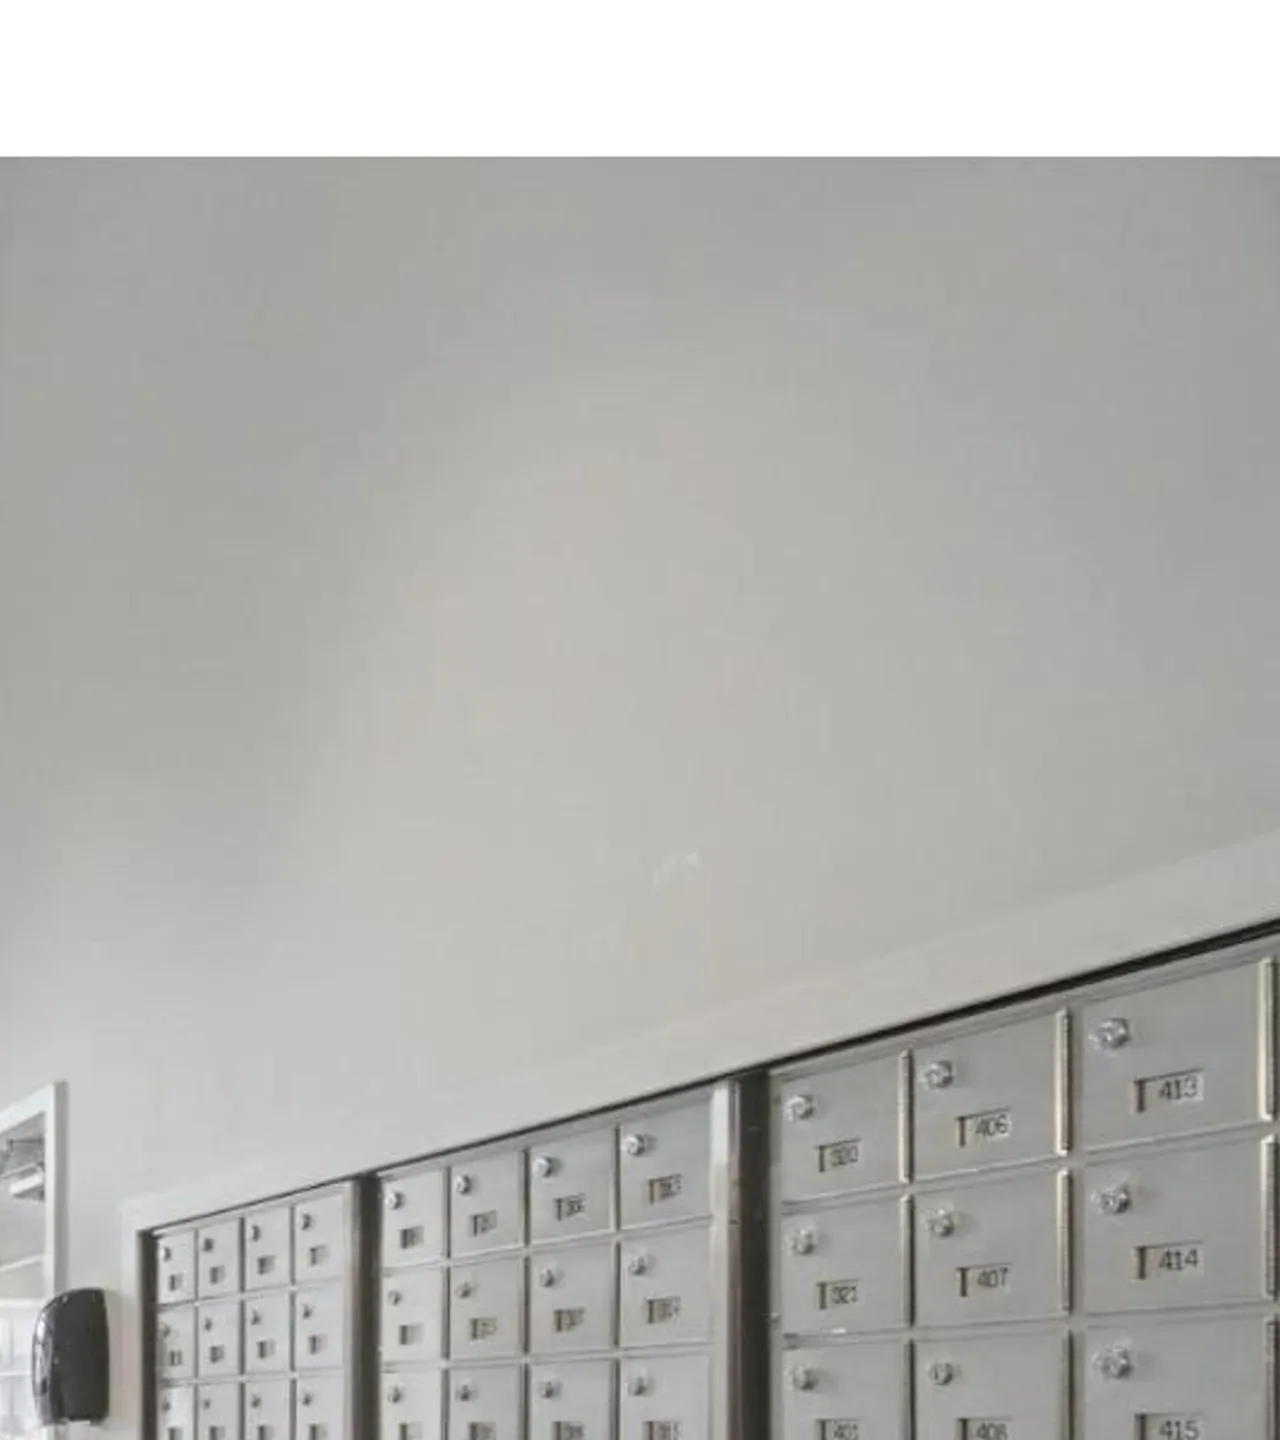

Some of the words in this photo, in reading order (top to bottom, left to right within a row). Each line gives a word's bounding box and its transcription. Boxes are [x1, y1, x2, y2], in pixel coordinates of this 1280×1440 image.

[1158, 1075, 1197, 1101] 413
[974, 1113, 1009, 1137] 406
[1158, 1248, 1198, 1271] 414
[975, 1267, 1008, 1288] 407
[1158, 1420, 1199, 1440] 415
